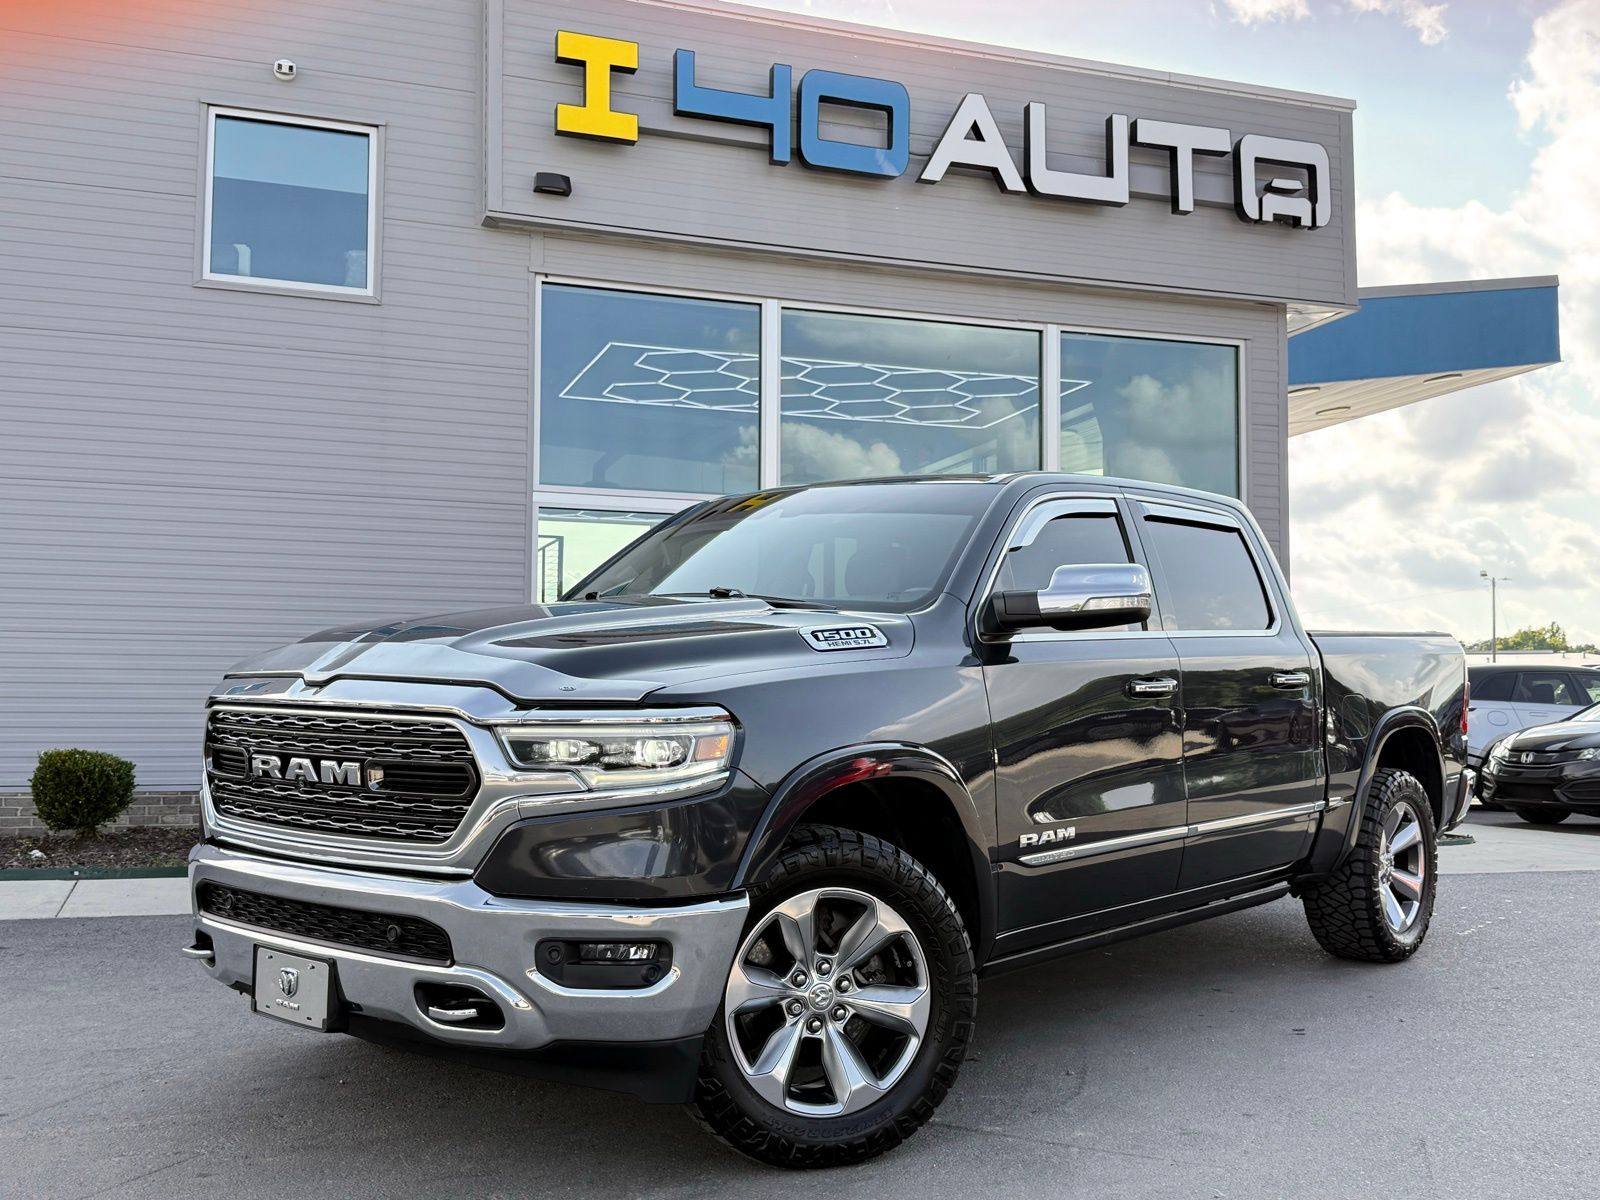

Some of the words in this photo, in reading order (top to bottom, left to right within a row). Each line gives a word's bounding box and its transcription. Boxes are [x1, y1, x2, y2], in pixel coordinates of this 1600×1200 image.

[914, 93, 1332, 230] AUTO
[813, 629, 872, 641] 1500
[251, 753, 362, 787] RAM
[1019, 826, 1076, 848] RAM
